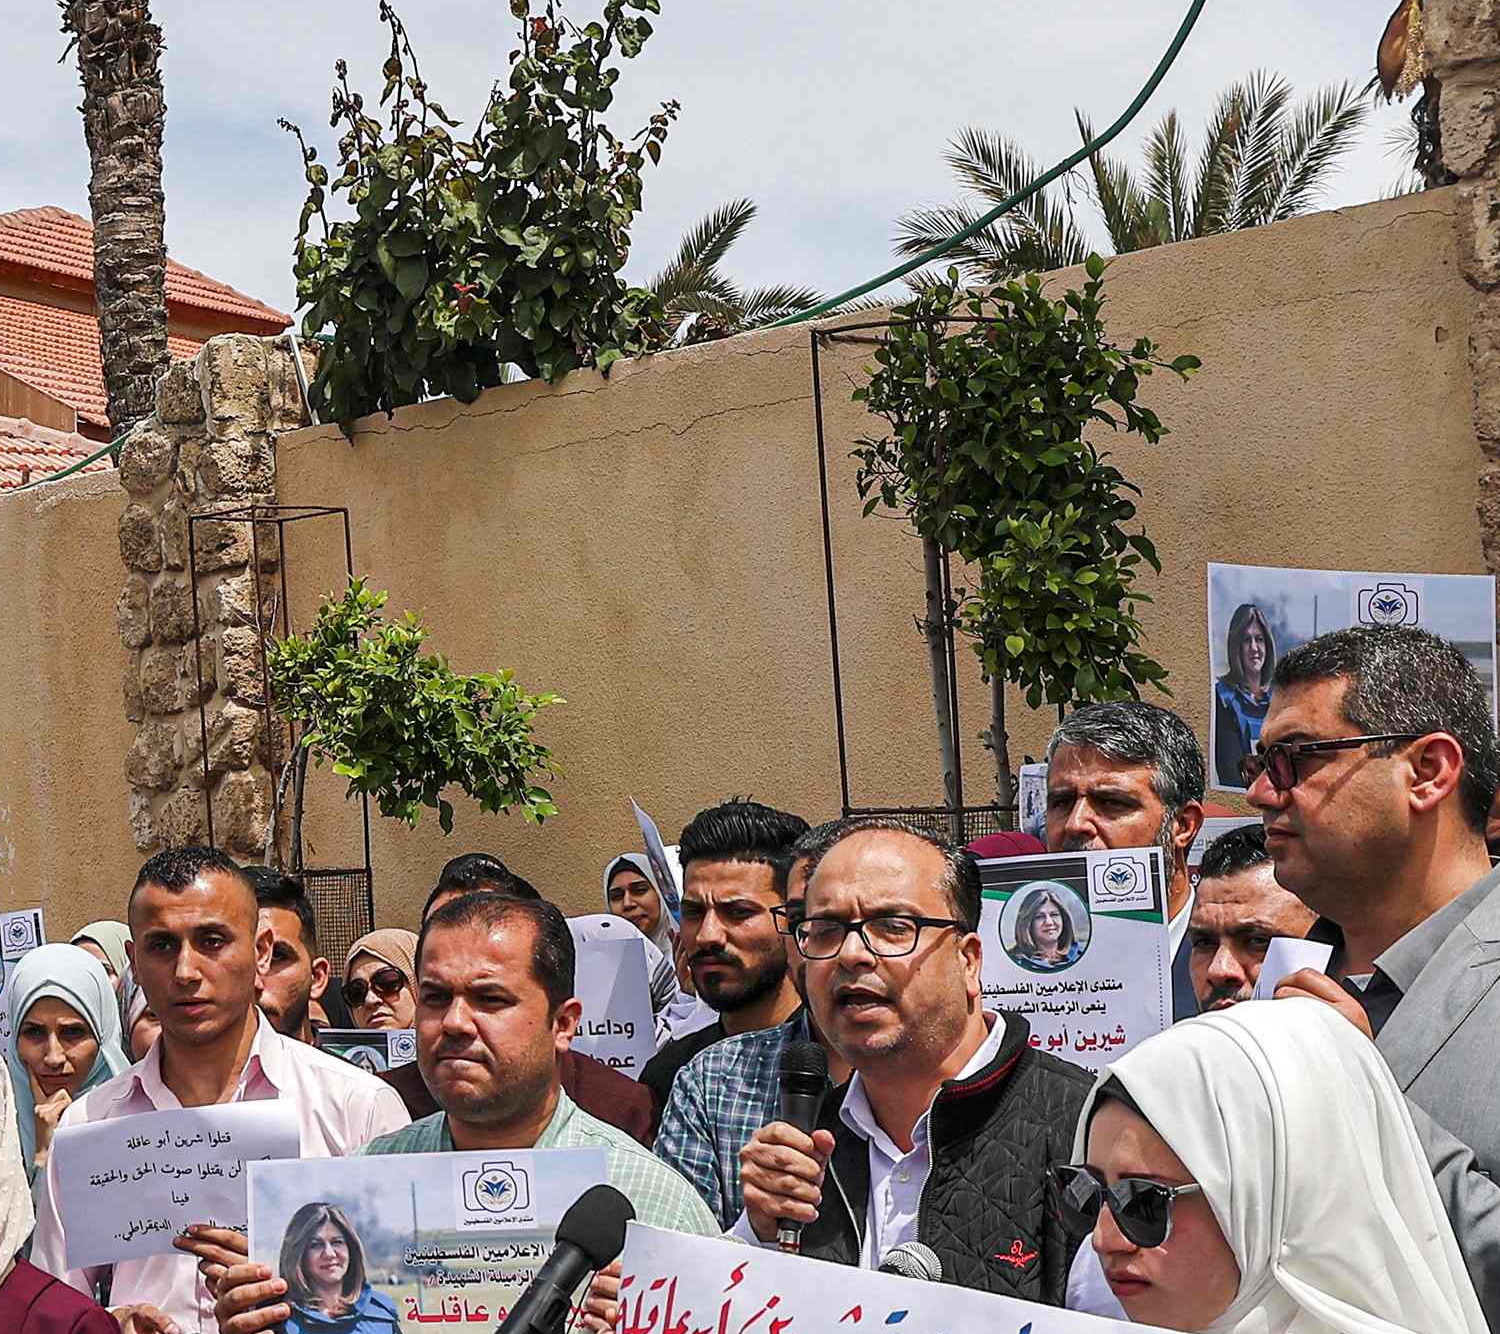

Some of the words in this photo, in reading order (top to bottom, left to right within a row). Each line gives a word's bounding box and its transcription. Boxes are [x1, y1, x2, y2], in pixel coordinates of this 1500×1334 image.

[1090, 980, 1123, 994] منتدى
[1041, 1000, 1079, 1017] الزميلة
[1080, 1002, 1106, 1014] ينعى
[1074, 1024, 1127, 1052] شيرين
[126, 1134, 151, 1151] عاقلة
[156, 1129, 171, 1149] أبو
[173, 1134, 204, 1150] شرين
[207, 1131, 232, 1146] قتلوا
[131, 1162, 157, 1182] الحق
[160, 1165, 193, 1179] صوت
[198, 1164, 225, 1180] يقتلوا
[227, 1159, 242, 1179] لن
[89, 1169, 129, 1188] والحقيقة
[403, 1245, 480, 1266] الفلسطينيين
[483, 1242, 546, 1264] الإعلاميين
[437, 1268, 486, 1289] الشهيدة
